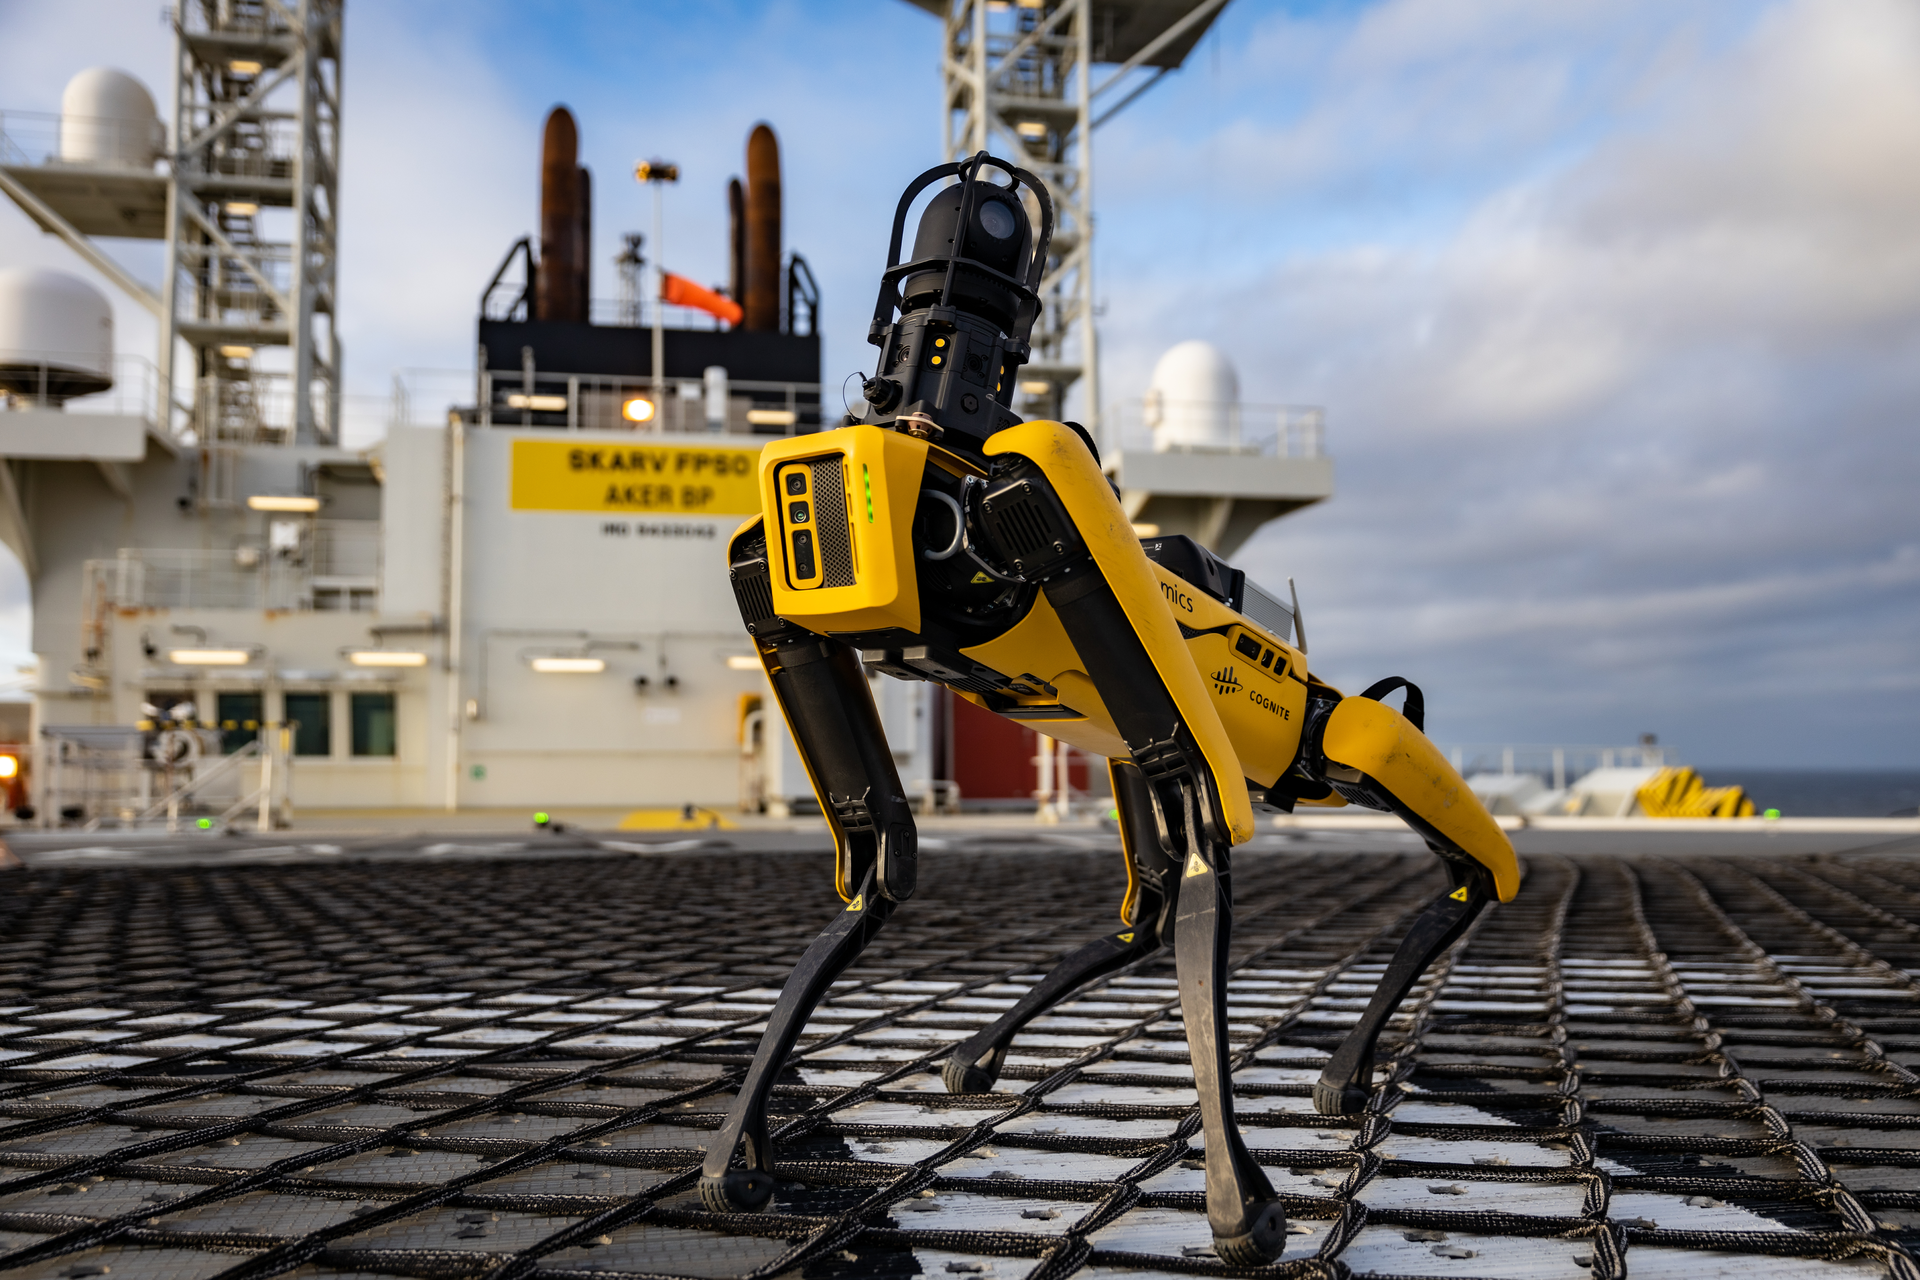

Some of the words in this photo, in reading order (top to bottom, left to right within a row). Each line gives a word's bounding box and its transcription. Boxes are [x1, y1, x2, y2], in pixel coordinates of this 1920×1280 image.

[569, 449, 668, 473] SKARV
[675, 452, 751, 477] FPSO
[604, 482, 674, 506] AKER
[680, 484, 715, 508] BP
[1250, 690, 1290, 721] COGNITE
